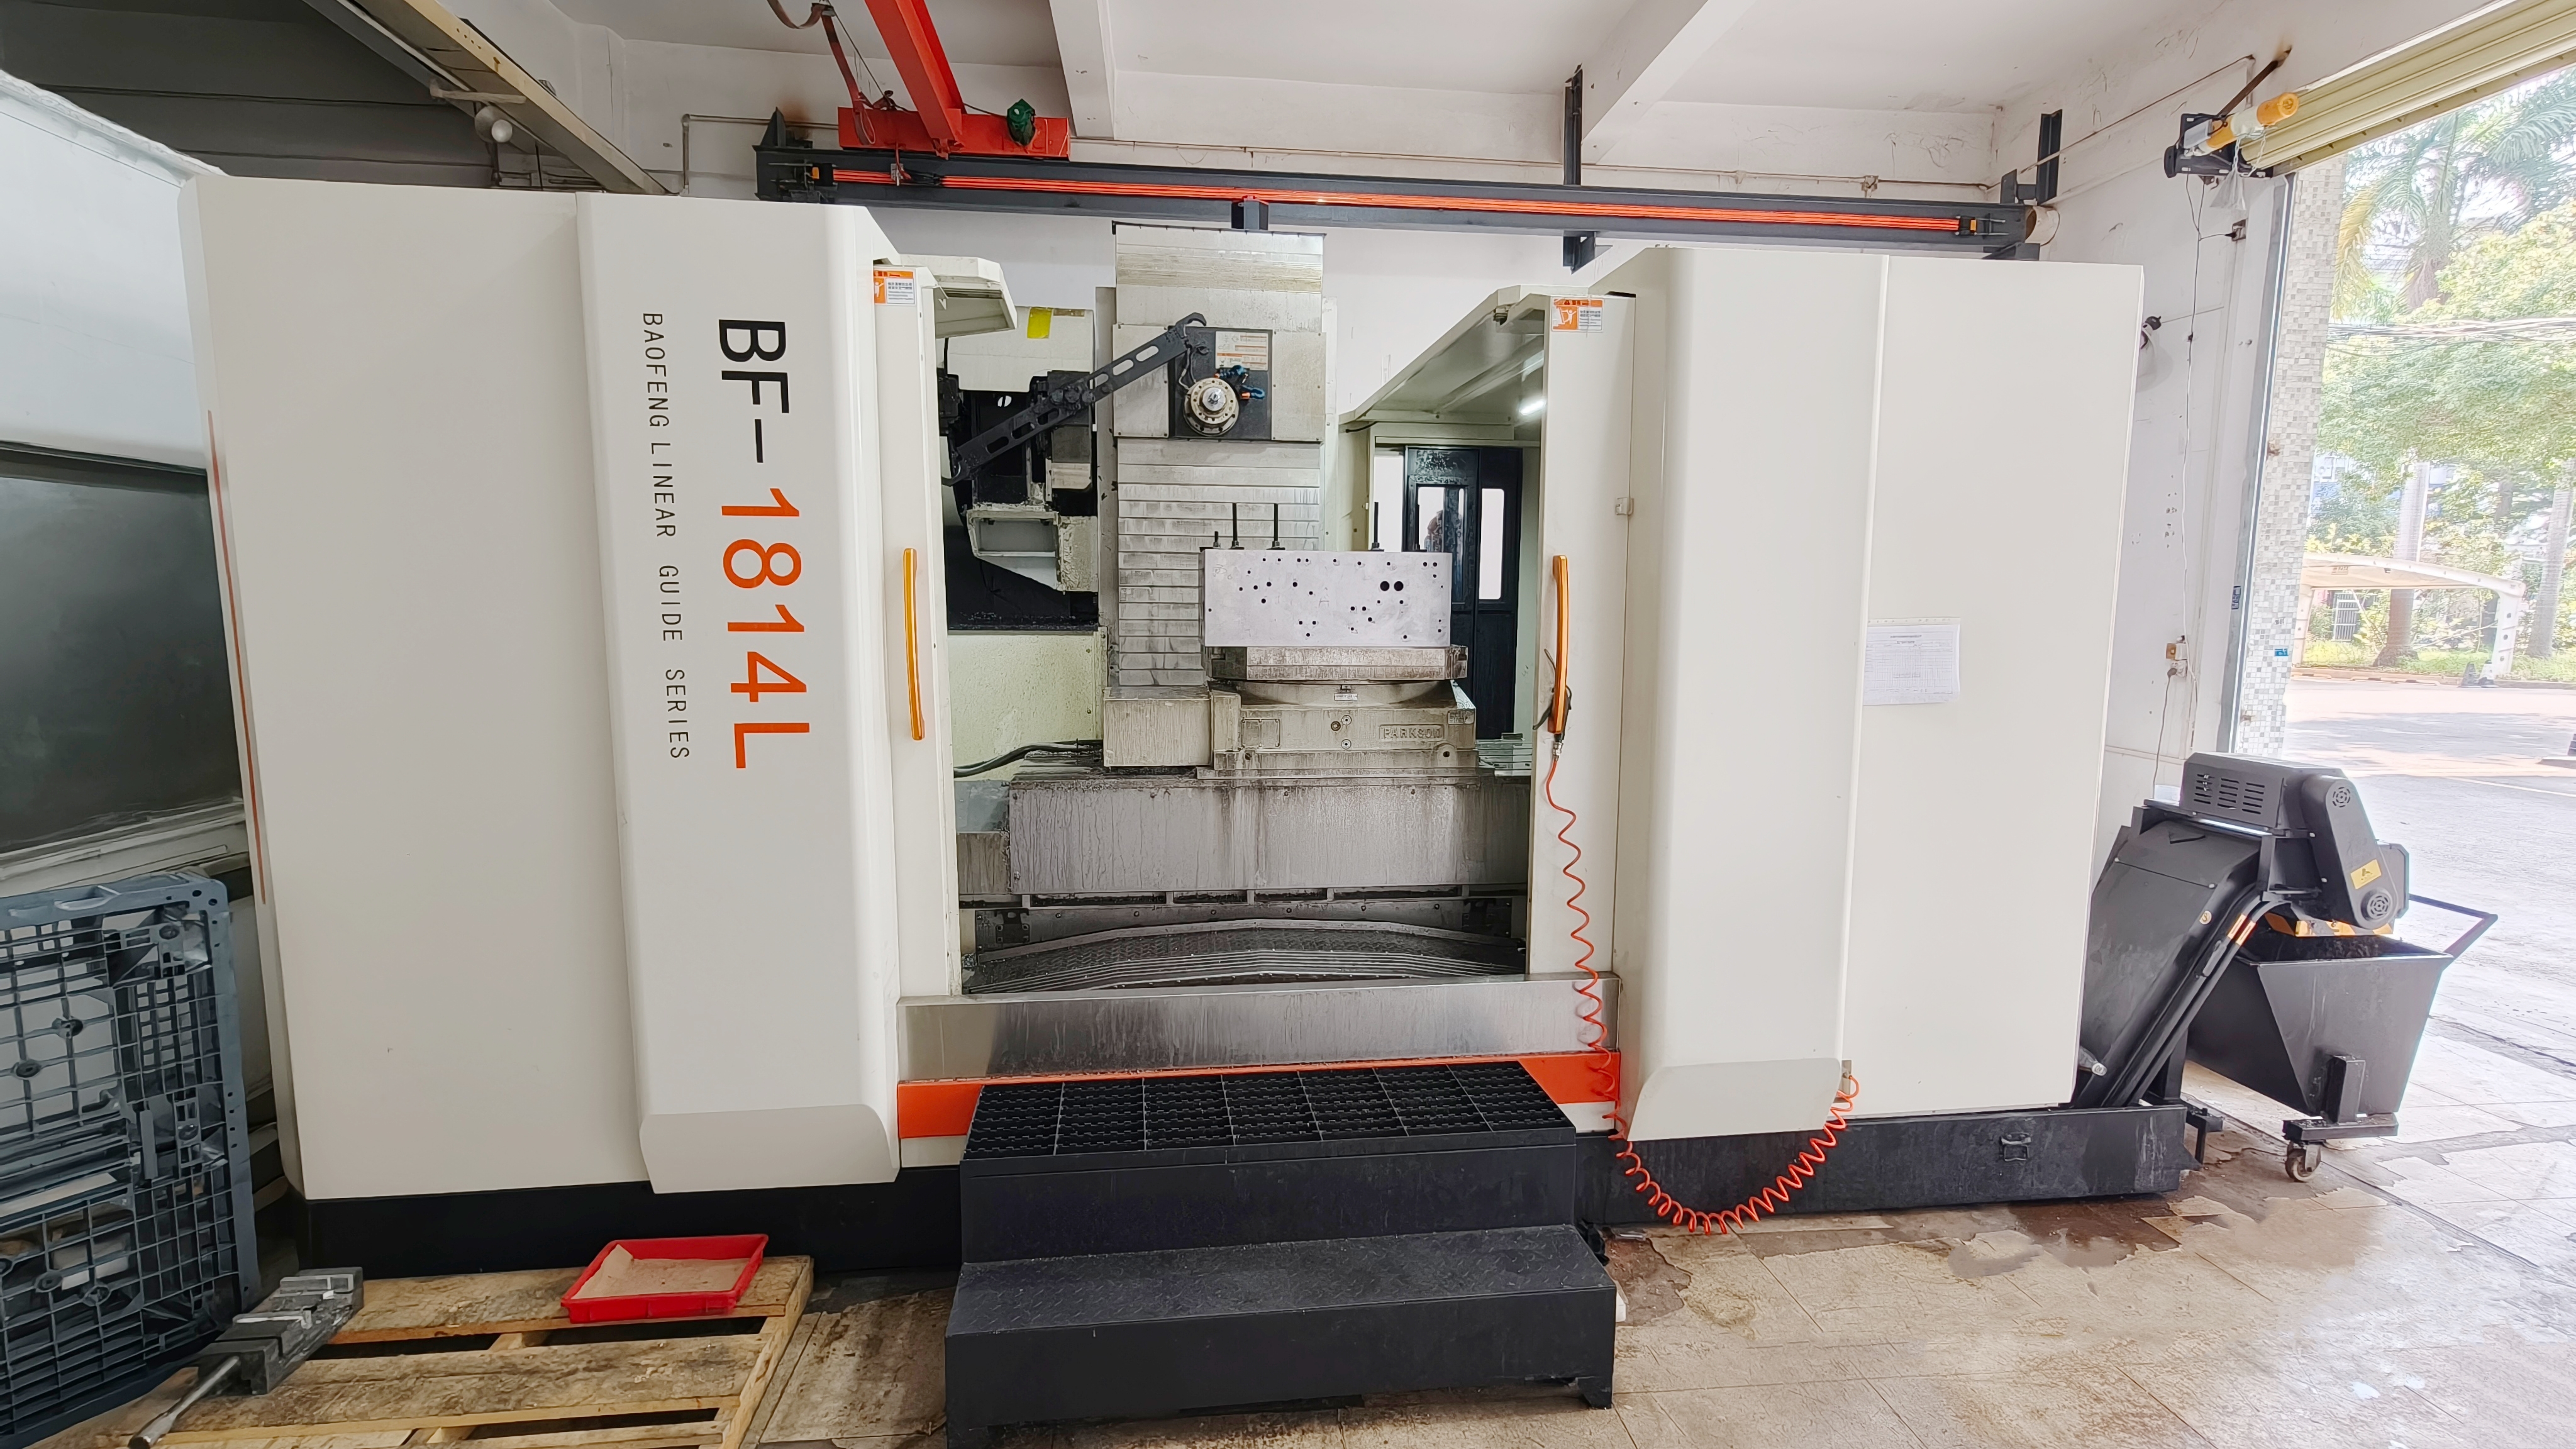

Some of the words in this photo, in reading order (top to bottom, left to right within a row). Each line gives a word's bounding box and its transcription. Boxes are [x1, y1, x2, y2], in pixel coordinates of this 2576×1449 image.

[643, 313, 670, 427] BAOFENG
[651, 442, 677, 538] LINEAR
[719, 319, 811, 770] BF-1814L
[659, 565, 683, 641] GUIDE
[665, 669, 690, 758] SERIES
